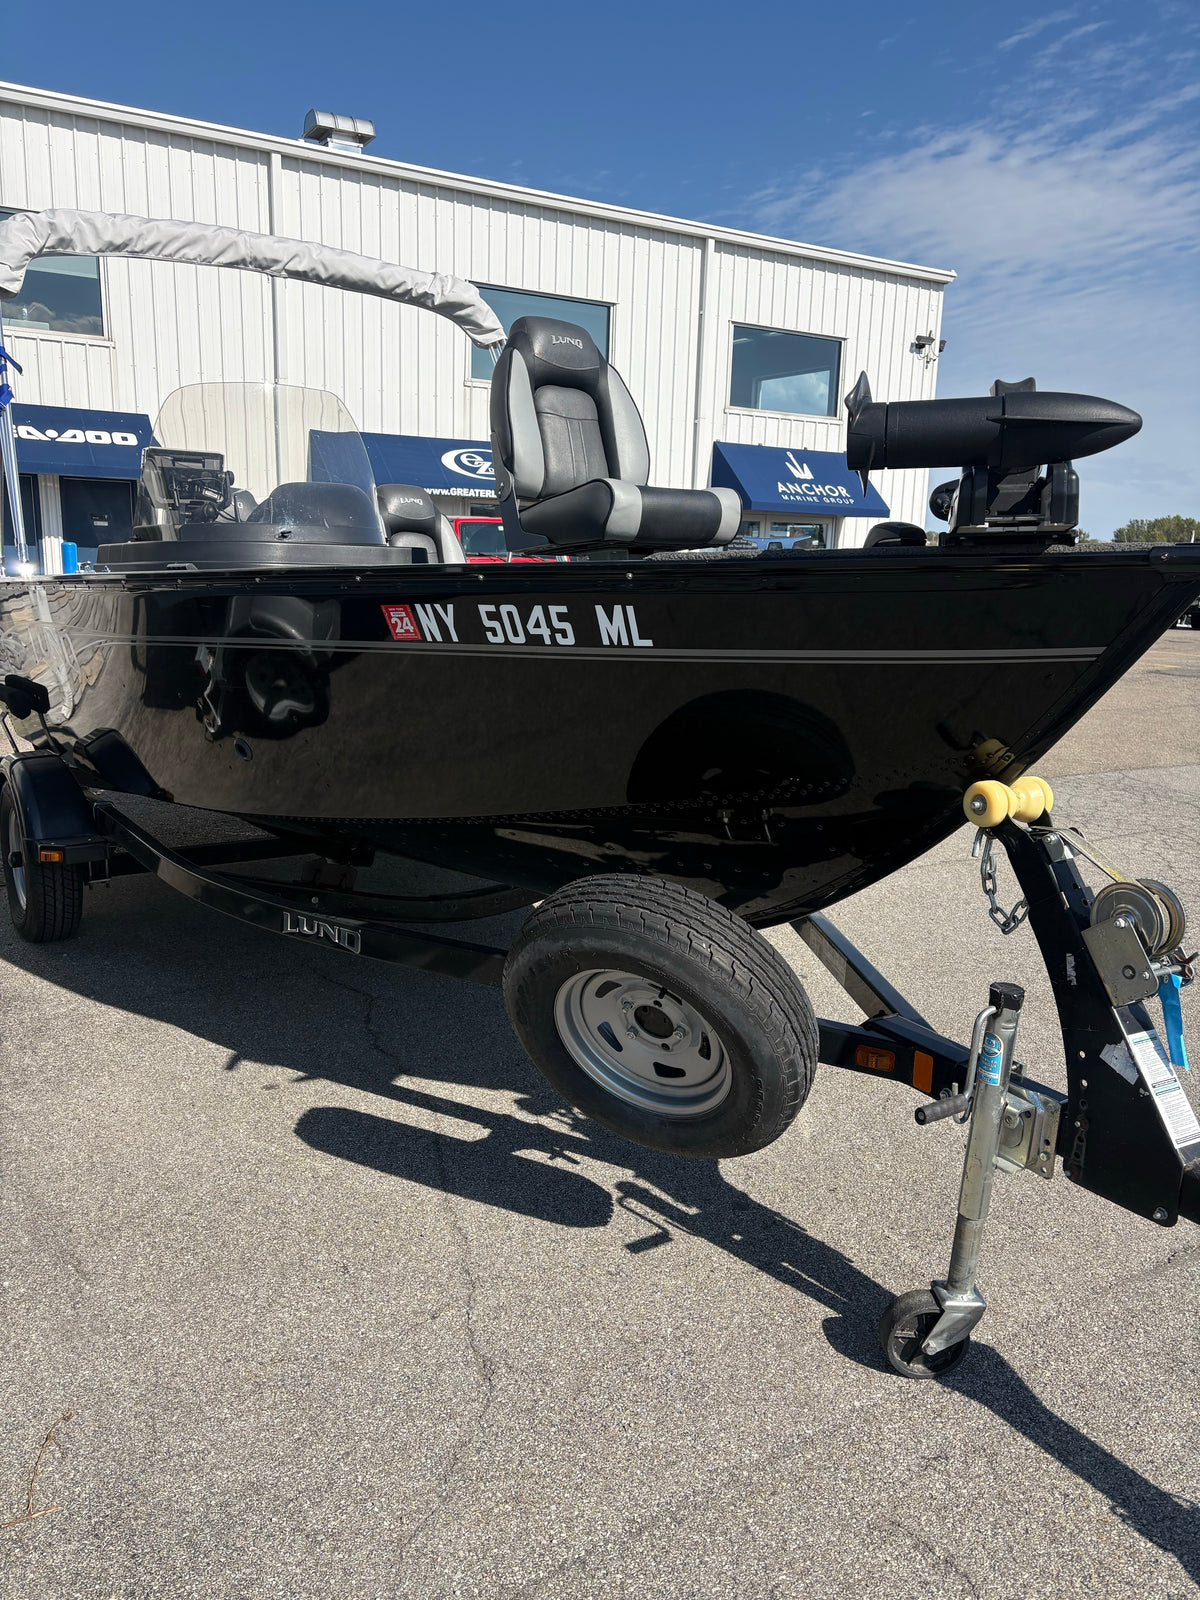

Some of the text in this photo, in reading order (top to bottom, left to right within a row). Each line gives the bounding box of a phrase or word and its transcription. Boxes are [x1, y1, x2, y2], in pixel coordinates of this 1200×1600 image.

[551, 335, 583, 350] LUND
[777, 481, 851, 498] ANCHOR
[400, 497, 423, 506] LUND
[781, 494, 855, 505] MARINE GROUP
[391, 617, 415, 633] 24
[414, 603, 654, 647] NY 5045 ML
[282, 911, 362, 954] LUND
